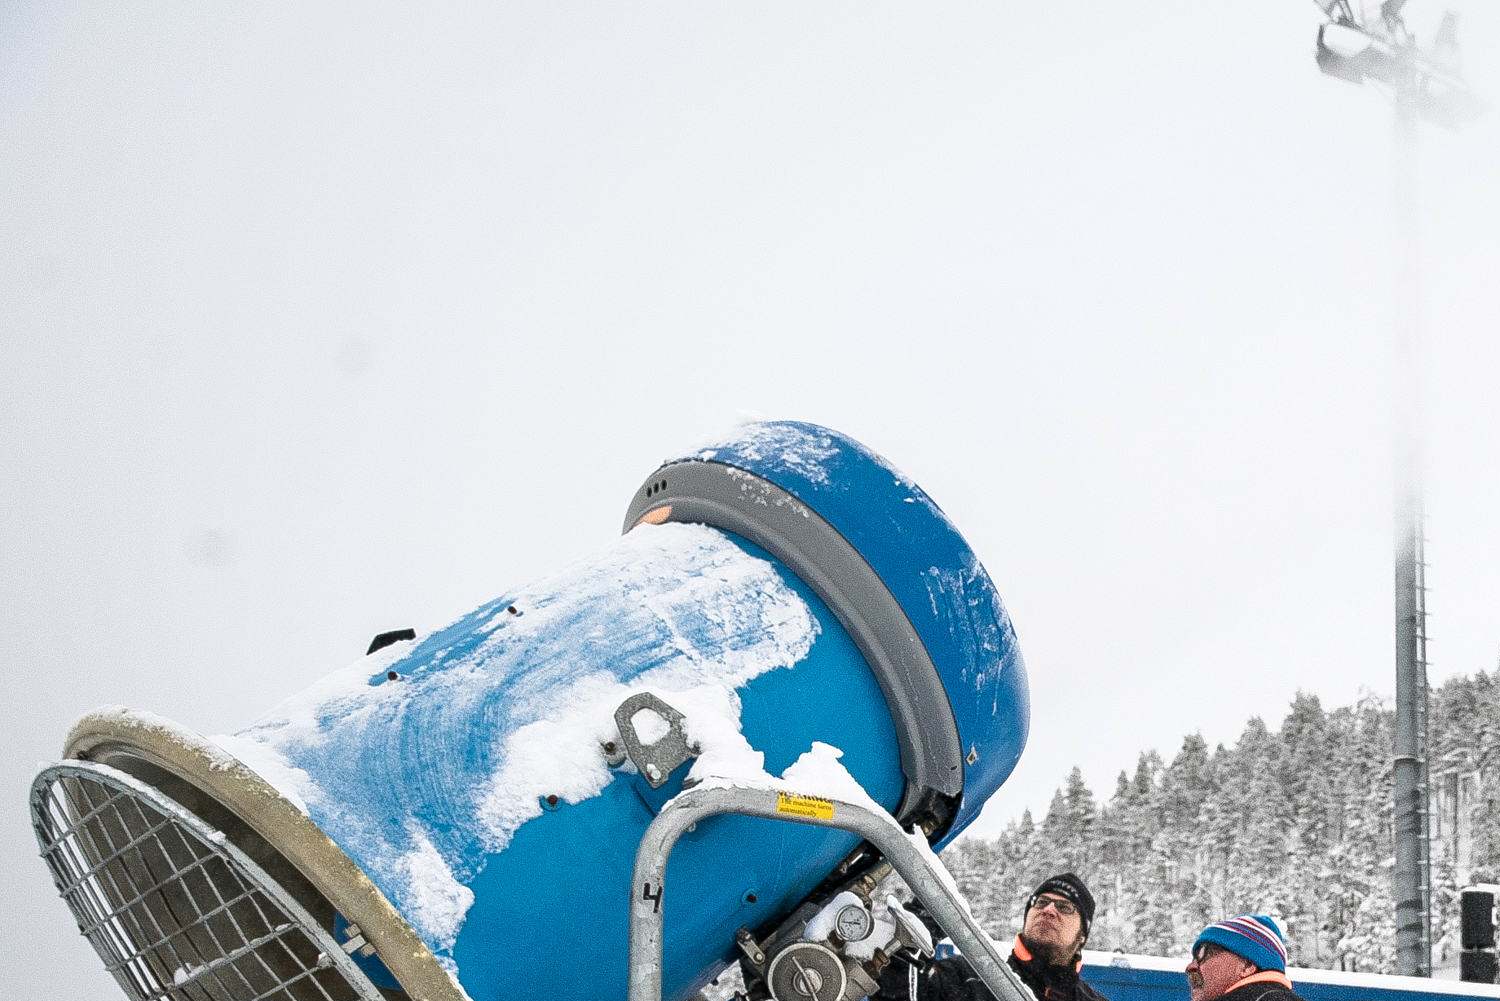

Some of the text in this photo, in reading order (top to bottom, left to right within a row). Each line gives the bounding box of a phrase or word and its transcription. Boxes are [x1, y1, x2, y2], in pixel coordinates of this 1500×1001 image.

[792, 800, 817, 808] machine
[779, 807, 817, 817] automatically
[643, 882, 663, 914] 4
